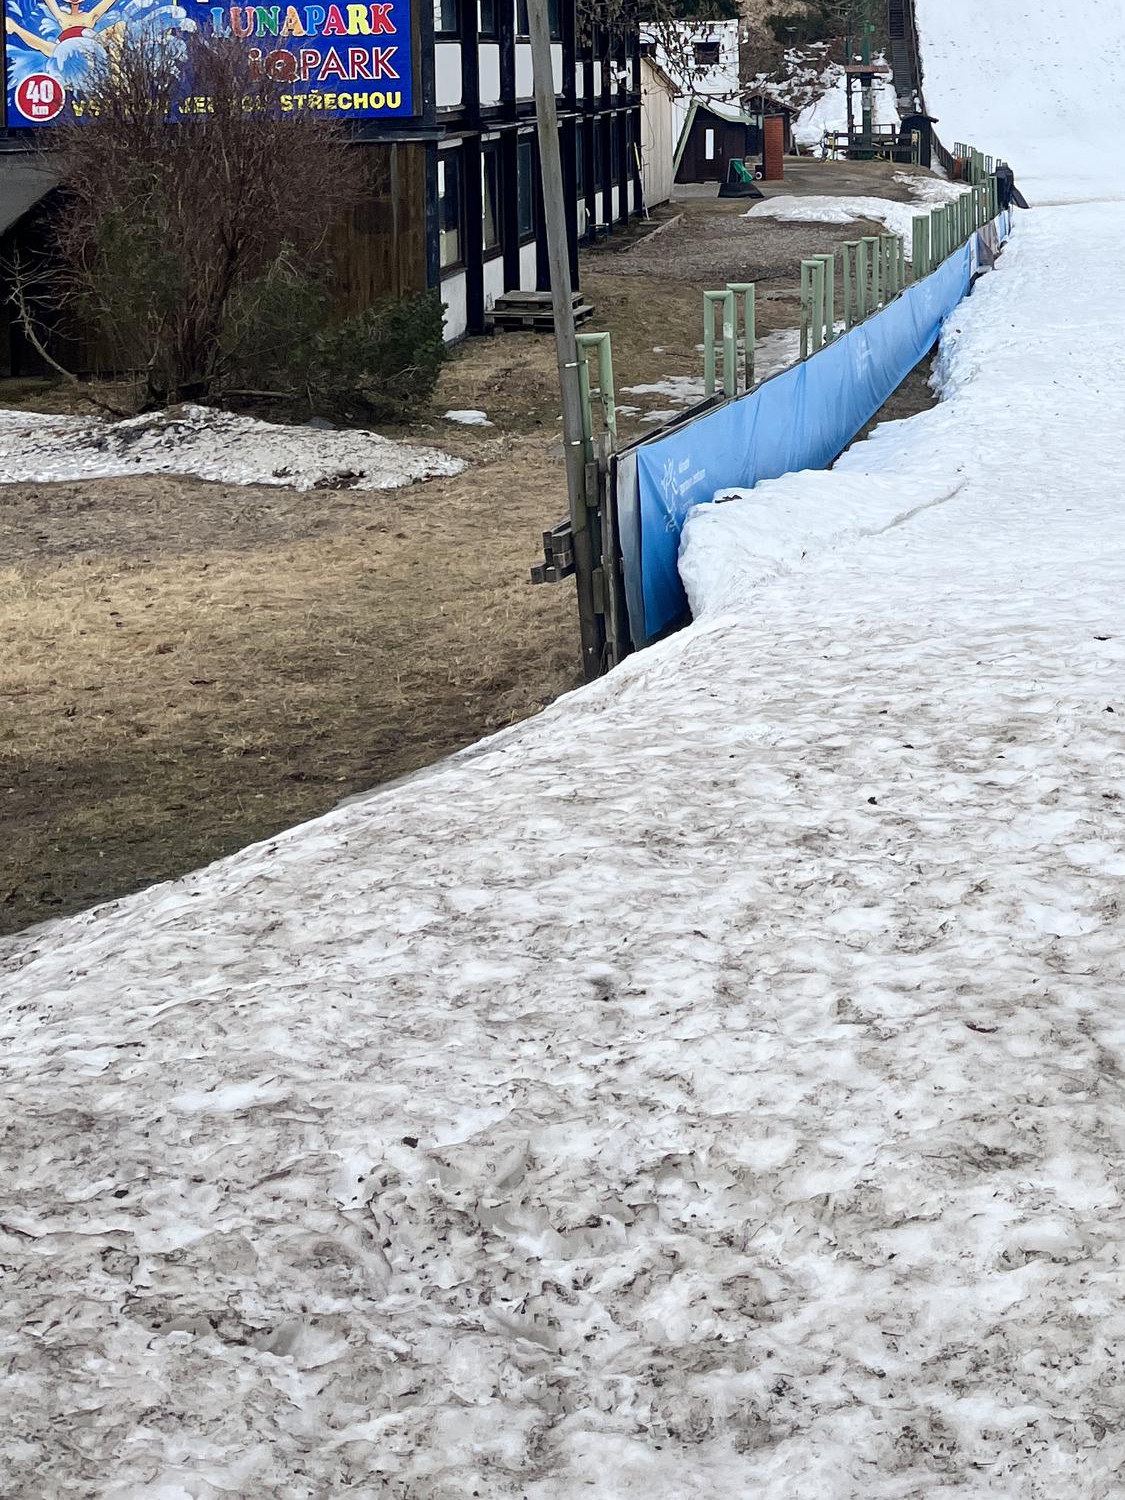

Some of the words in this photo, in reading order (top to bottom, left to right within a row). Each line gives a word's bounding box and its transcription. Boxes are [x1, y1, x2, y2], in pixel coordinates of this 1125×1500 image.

[210, 3, 397, 37] LUNAPARK
[26, 79, 54, 103] 40
[279, 89, 402, 113] STŘECHOU
[32, 104, 49, 116] km
